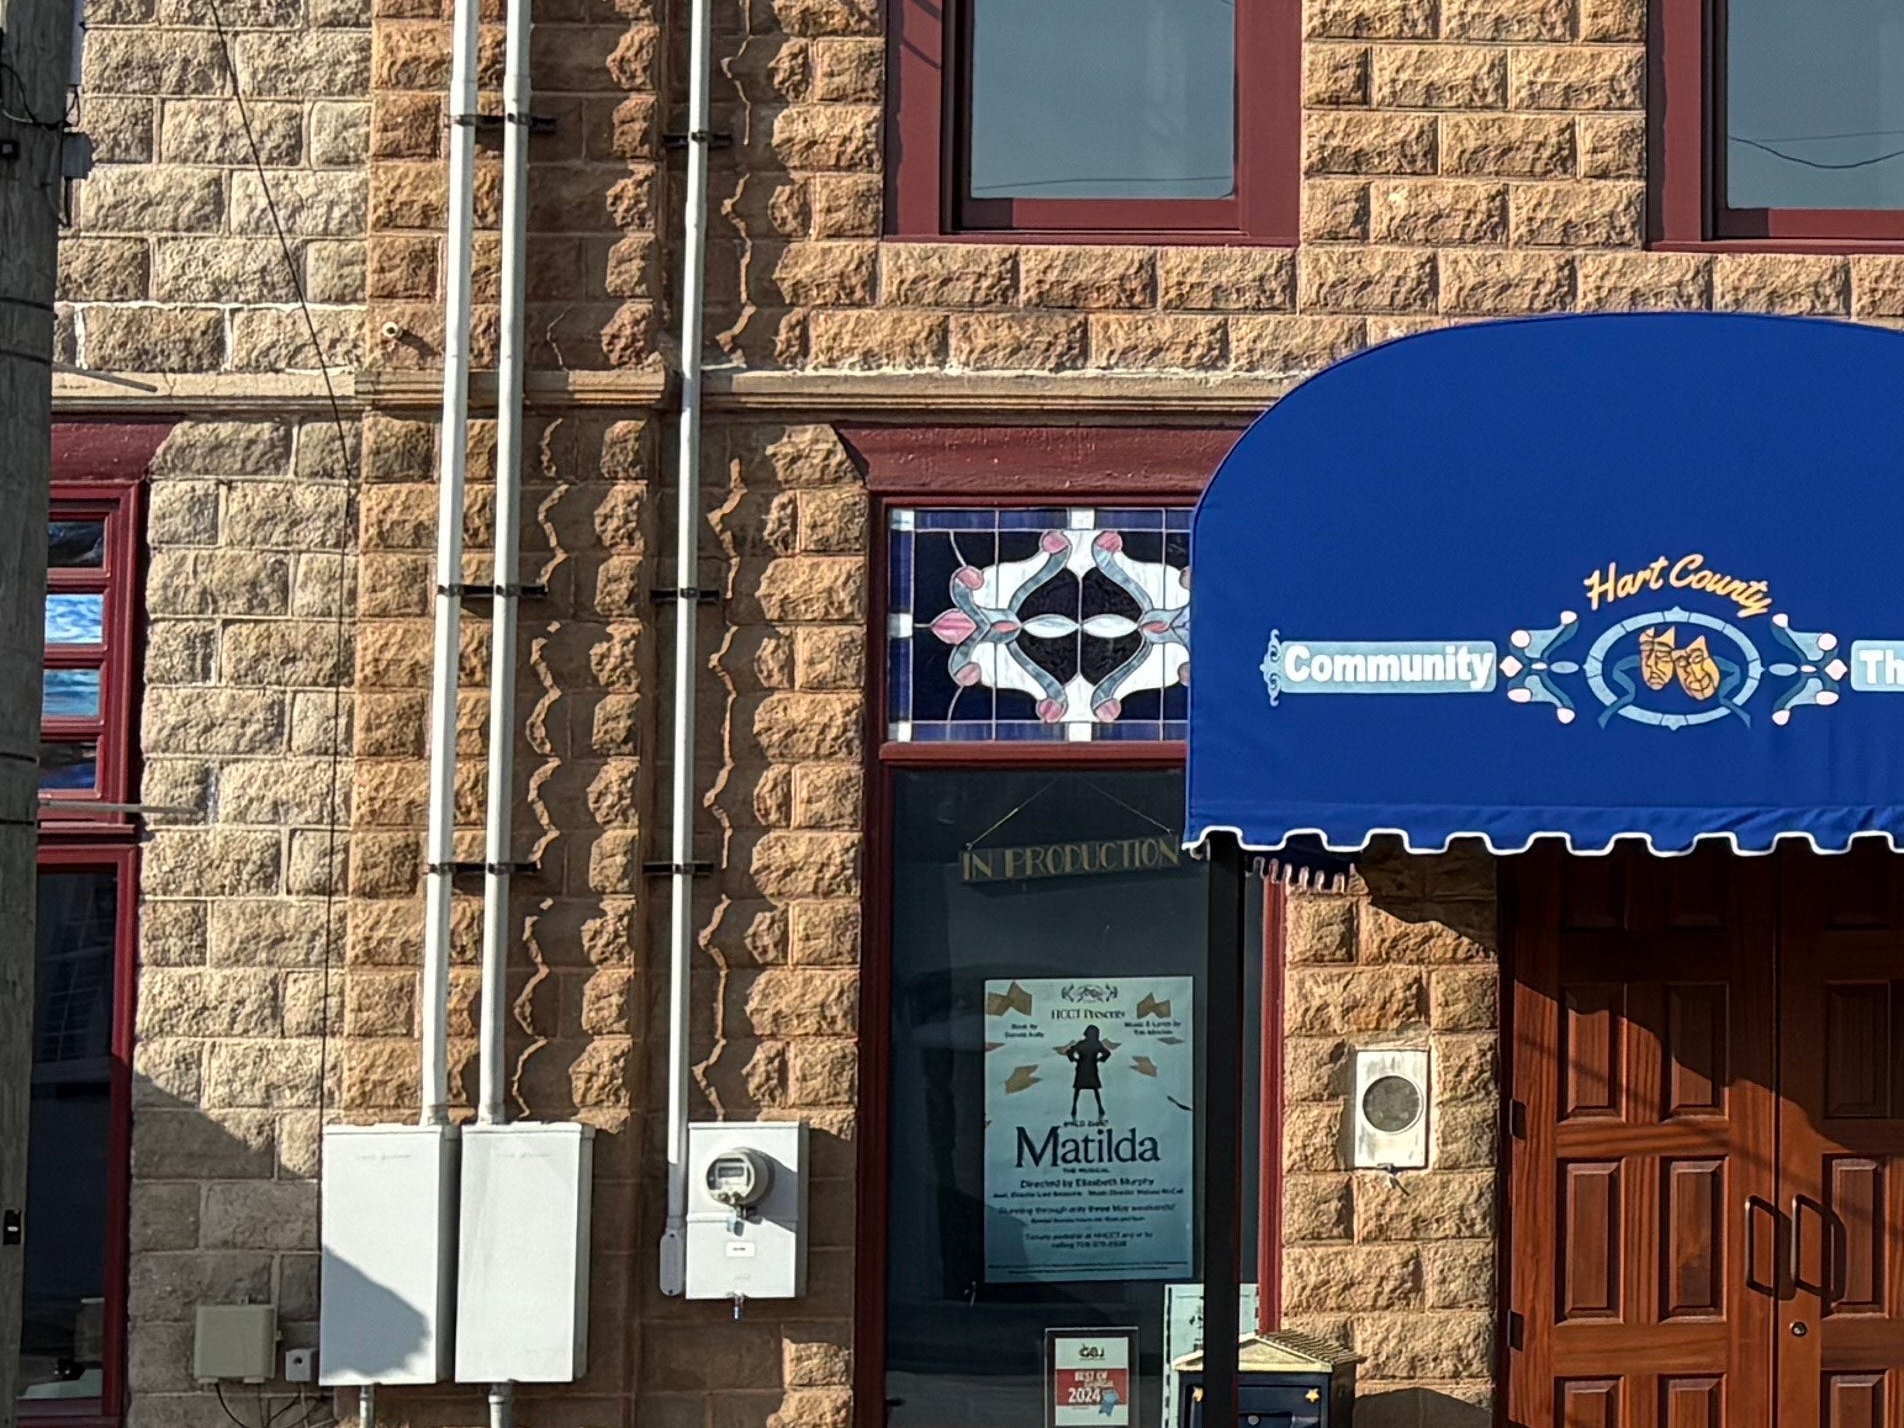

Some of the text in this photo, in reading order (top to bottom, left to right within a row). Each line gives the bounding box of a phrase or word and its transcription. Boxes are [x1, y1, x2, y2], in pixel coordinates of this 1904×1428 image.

[1584, 552, 1774, 618] Hart County
[1283, 645, 1496, 688] Community
[962, 839, 1181, 882] IN PRODUCTION
[1014, 1125, 1161, 1168] Matilda
[1068, 1386, 1101, 1403] 2024
